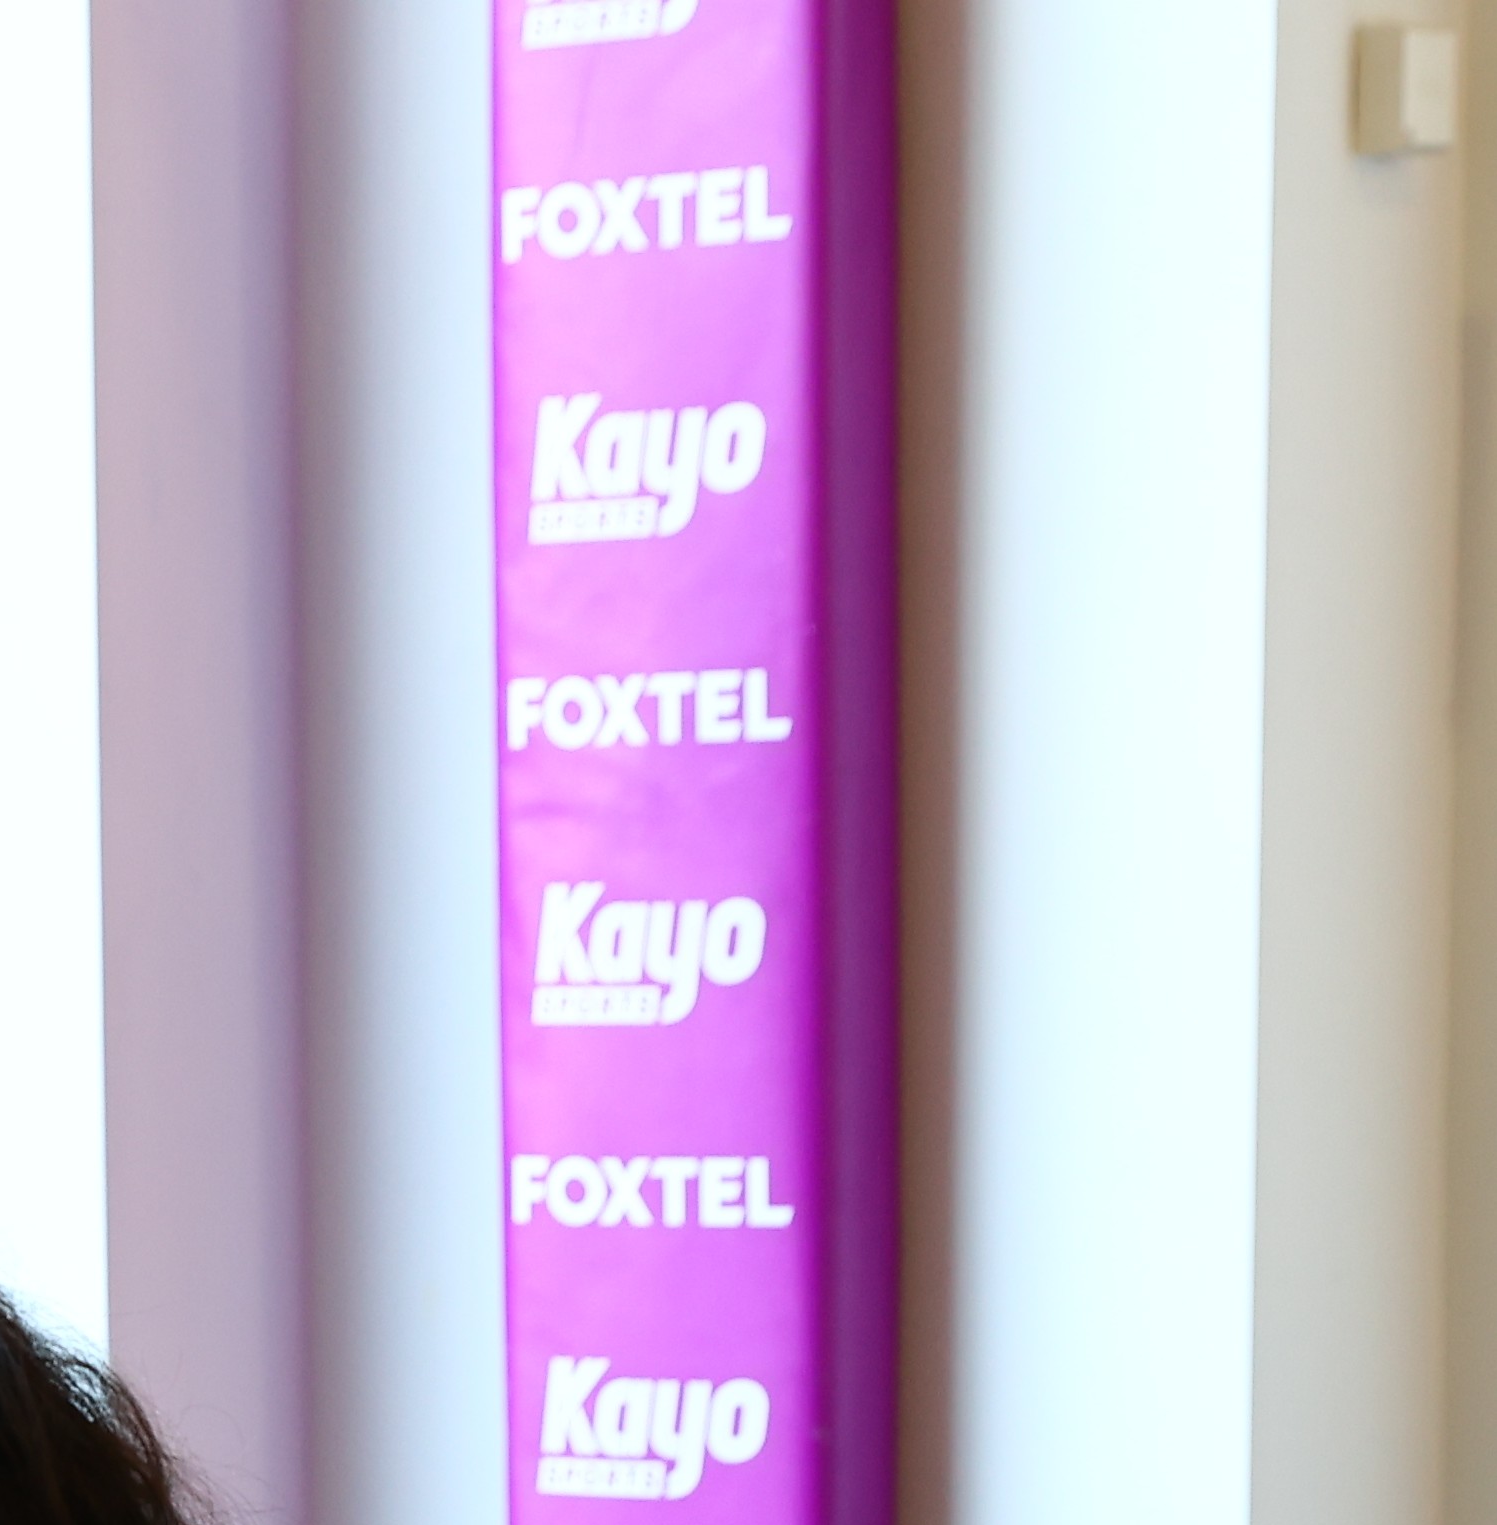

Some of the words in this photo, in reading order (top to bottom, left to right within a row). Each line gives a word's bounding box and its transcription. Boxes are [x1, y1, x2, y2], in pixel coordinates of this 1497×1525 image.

[501, 165, 793, 264] FOXTEL
[529, 392, 767, 538] Kayo
[506, 668, 792, 751] FOXTEL
[534, 880, 766, 1025] Kayo
[511, 1154, 794, 1228] FOXTEL
[541, 1355, 770, 1500] Kayo
